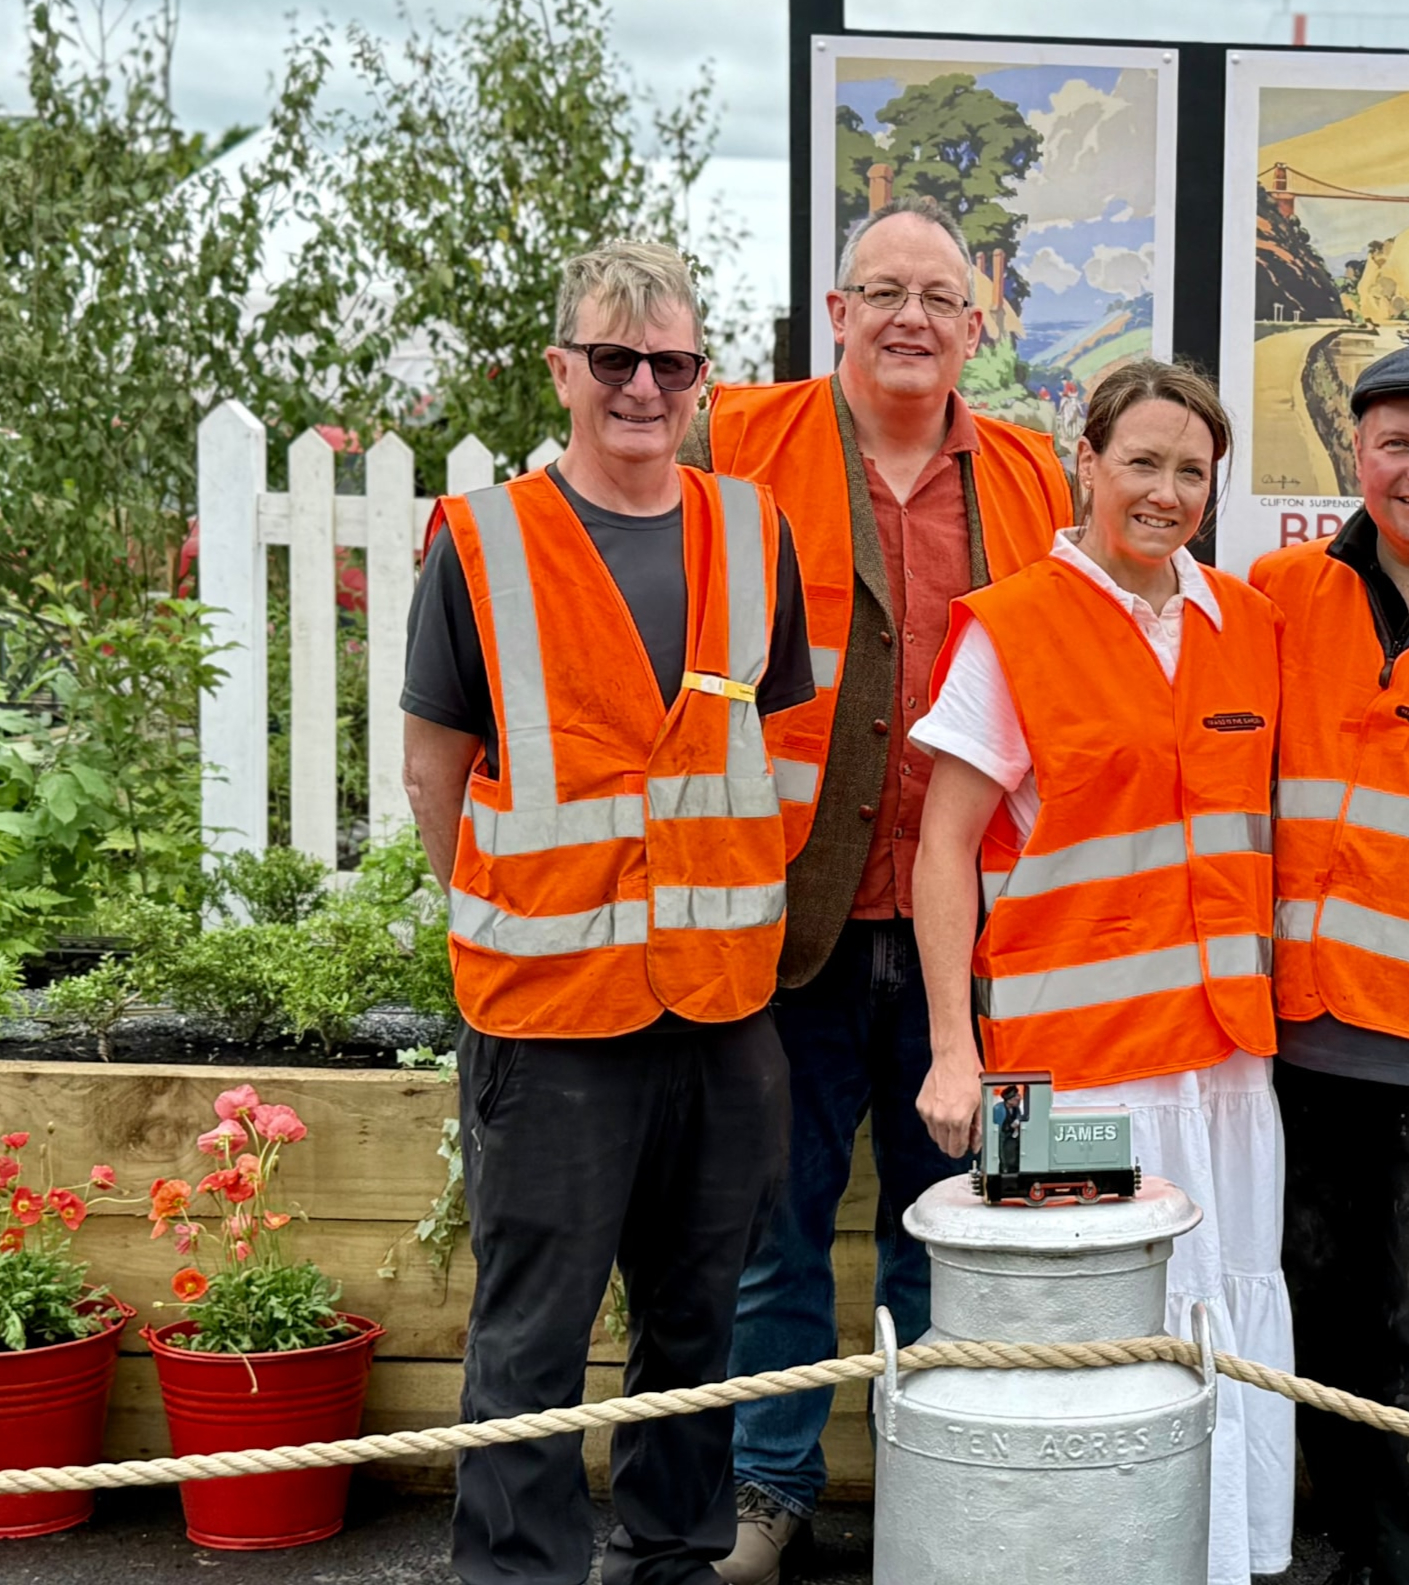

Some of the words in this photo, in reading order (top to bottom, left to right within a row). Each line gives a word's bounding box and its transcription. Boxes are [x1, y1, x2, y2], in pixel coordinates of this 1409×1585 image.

[1260, 497, 1304, 507] CLIFTON
[1310, 499, 1364, 508] SUSPENSIO
[1054, 1125, 1117, 1143] JAMES
[947, 1424, 1009, 1459] TEN
[1038, 1427, 1149, 1460] ACRES
